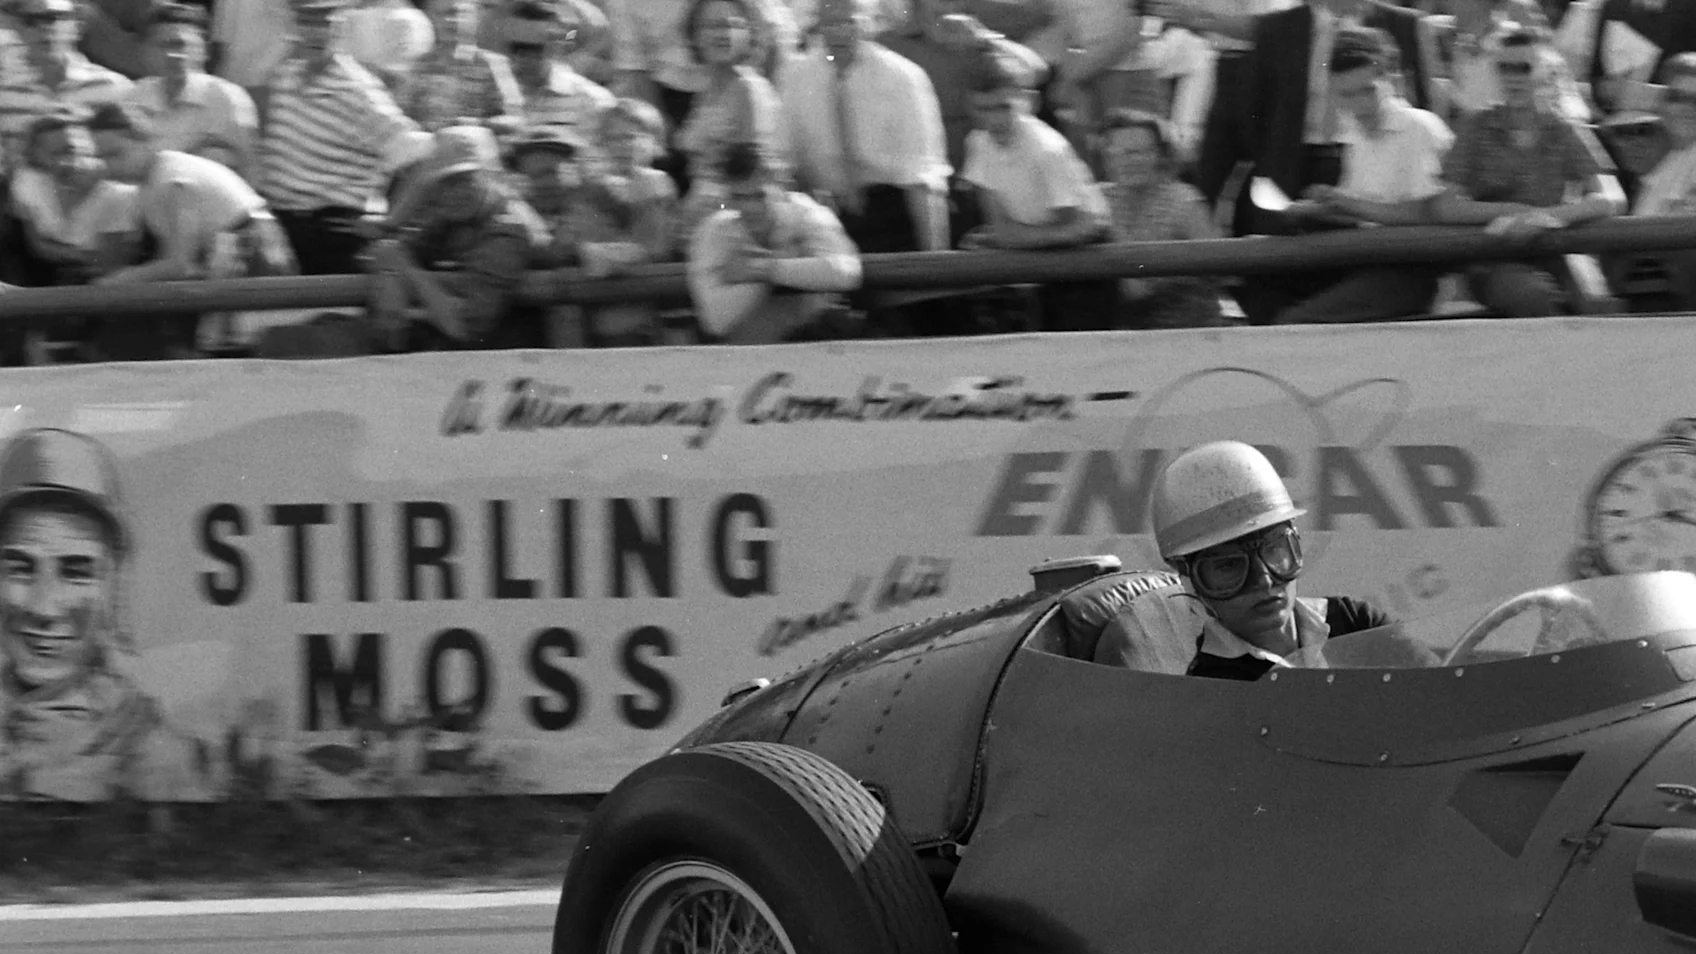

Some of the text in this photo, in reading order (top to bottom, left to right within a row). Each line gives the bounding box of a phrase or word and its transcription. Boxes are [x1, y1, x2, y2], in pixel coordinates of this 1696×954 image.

[498, 376, 722, 449] Winning
[974, 444, 1499, 537] ENAR
[197, 492, 779, 605] STIRLING
[299, 625, 682, 733] MOSS
